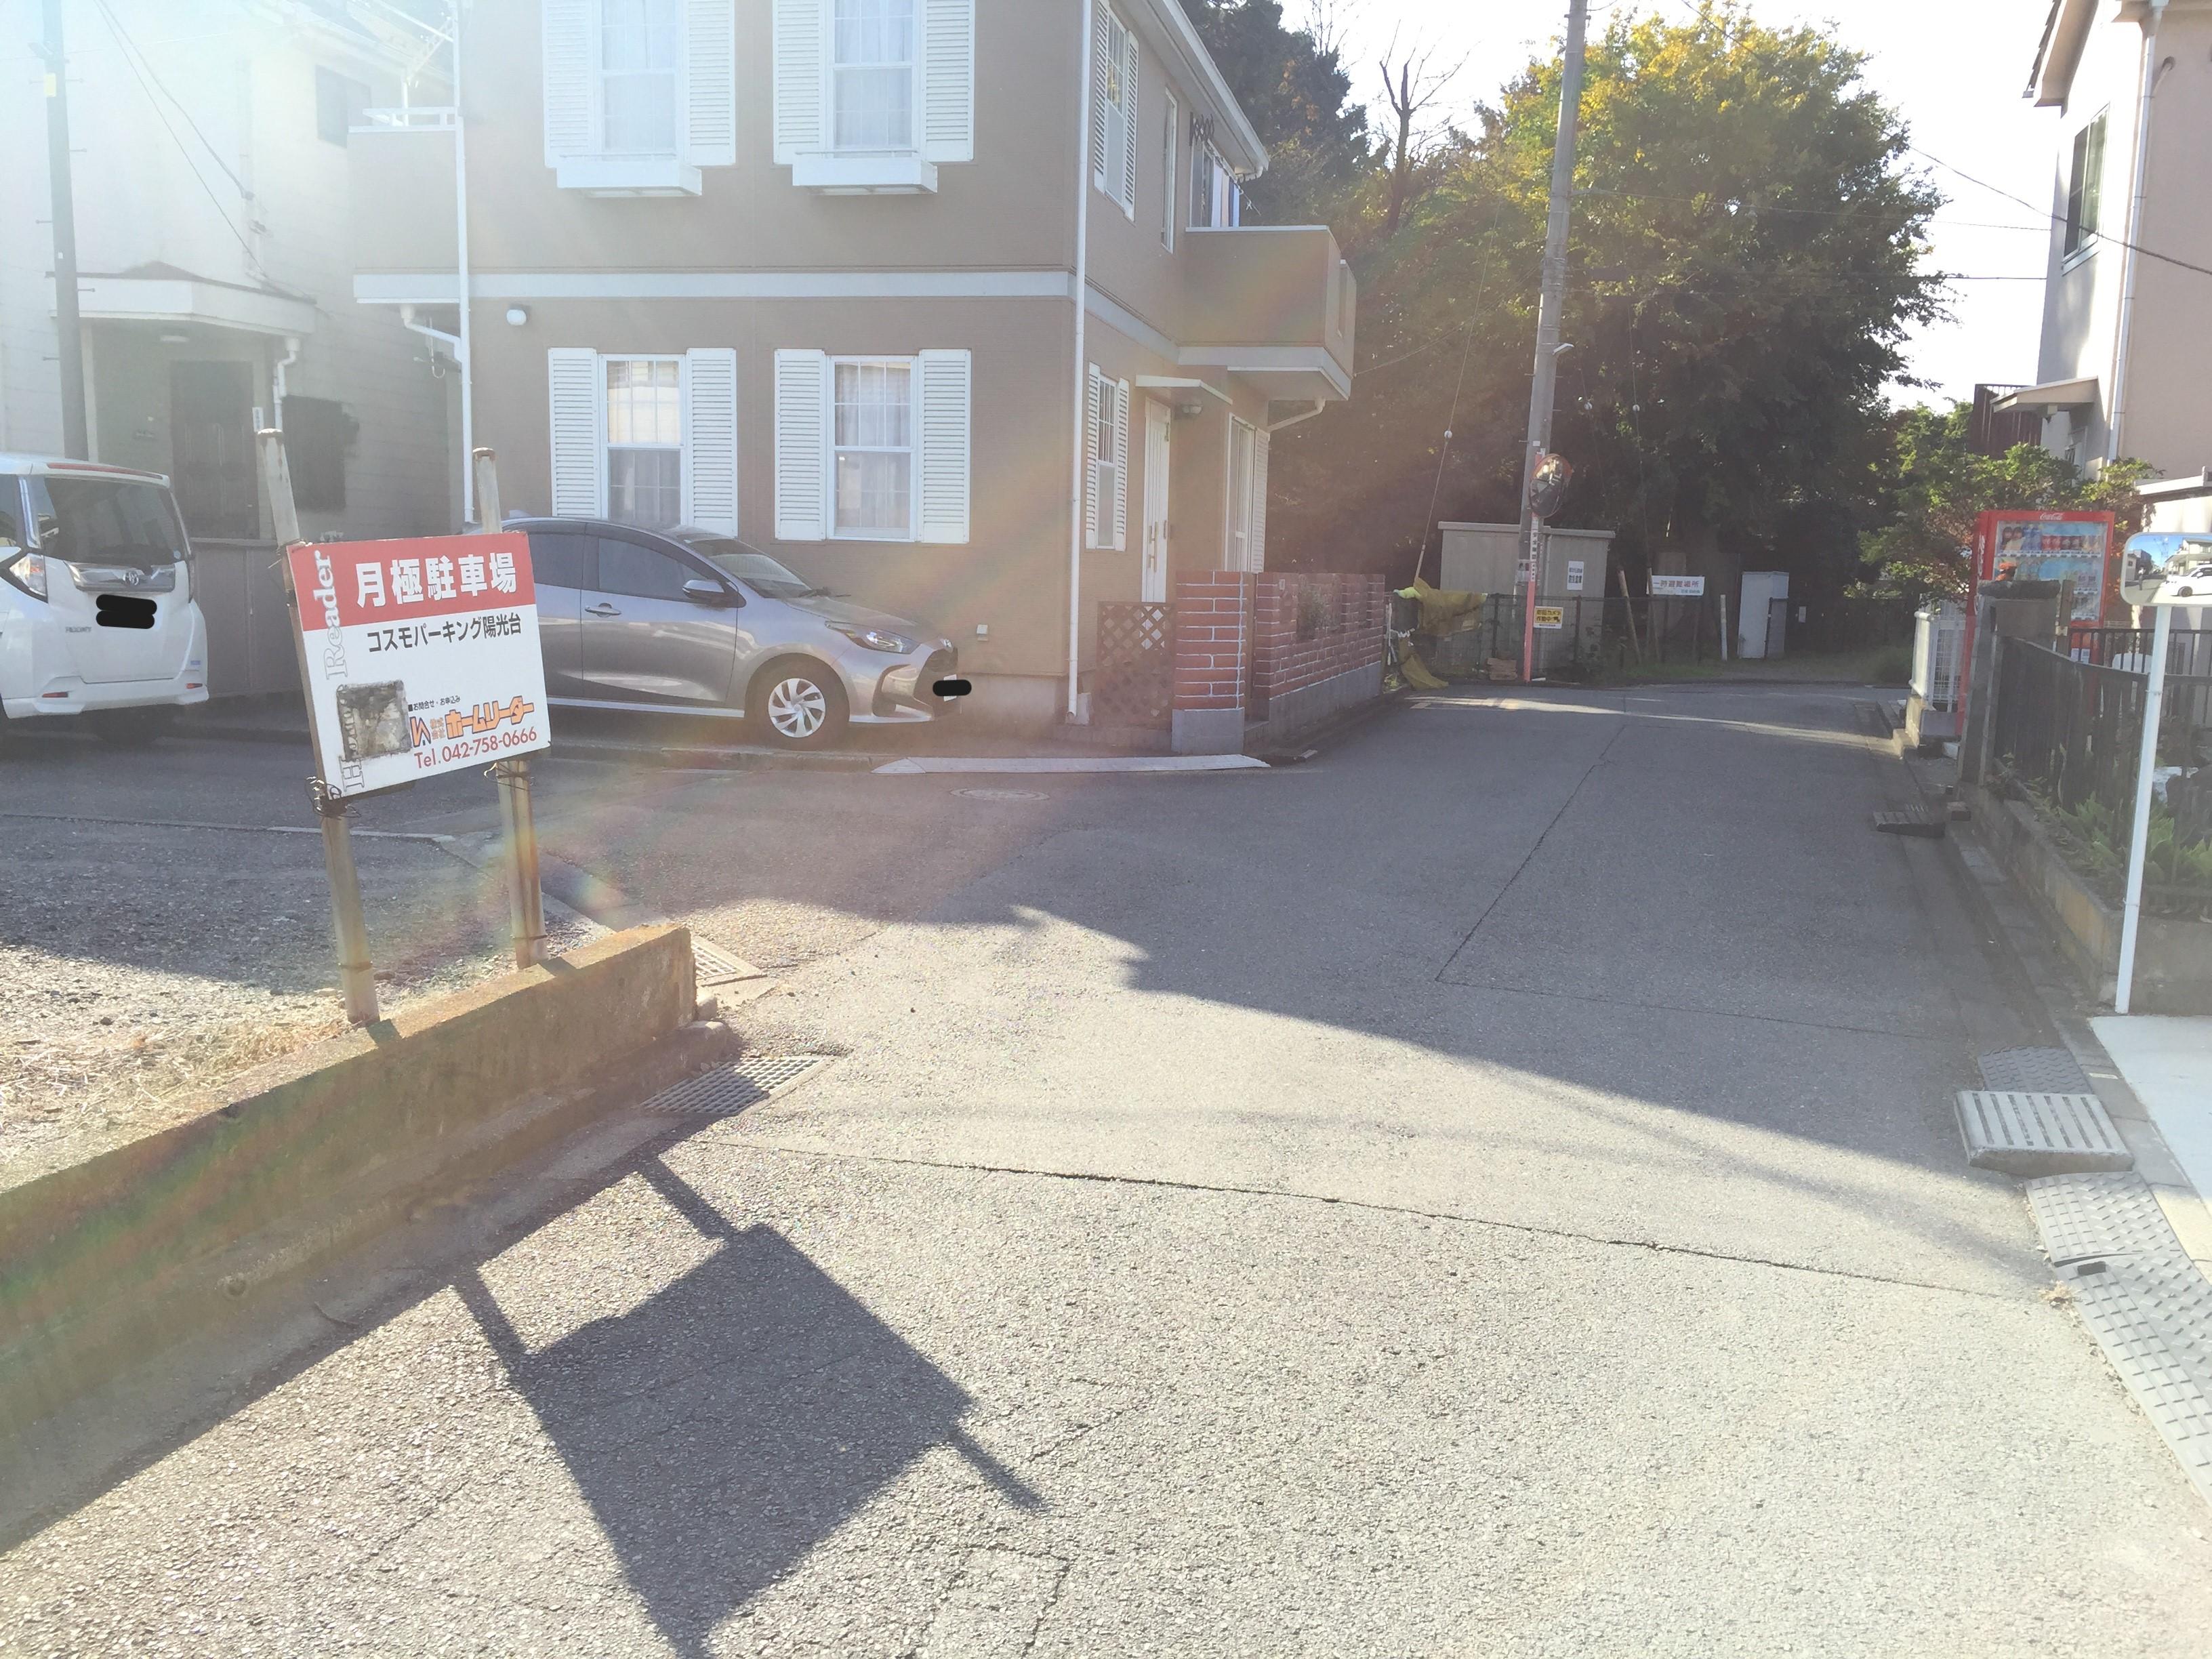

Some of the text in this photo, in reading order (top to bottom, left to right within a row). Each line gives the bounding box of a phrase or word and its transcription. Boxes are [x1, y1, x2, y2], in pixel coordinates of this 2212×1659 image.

[356, 552, 516, 608] 月極駐車場
[314, 550, 348, 680] Reader
[367, 613, 521, 652] コスモパーキング陽光台
